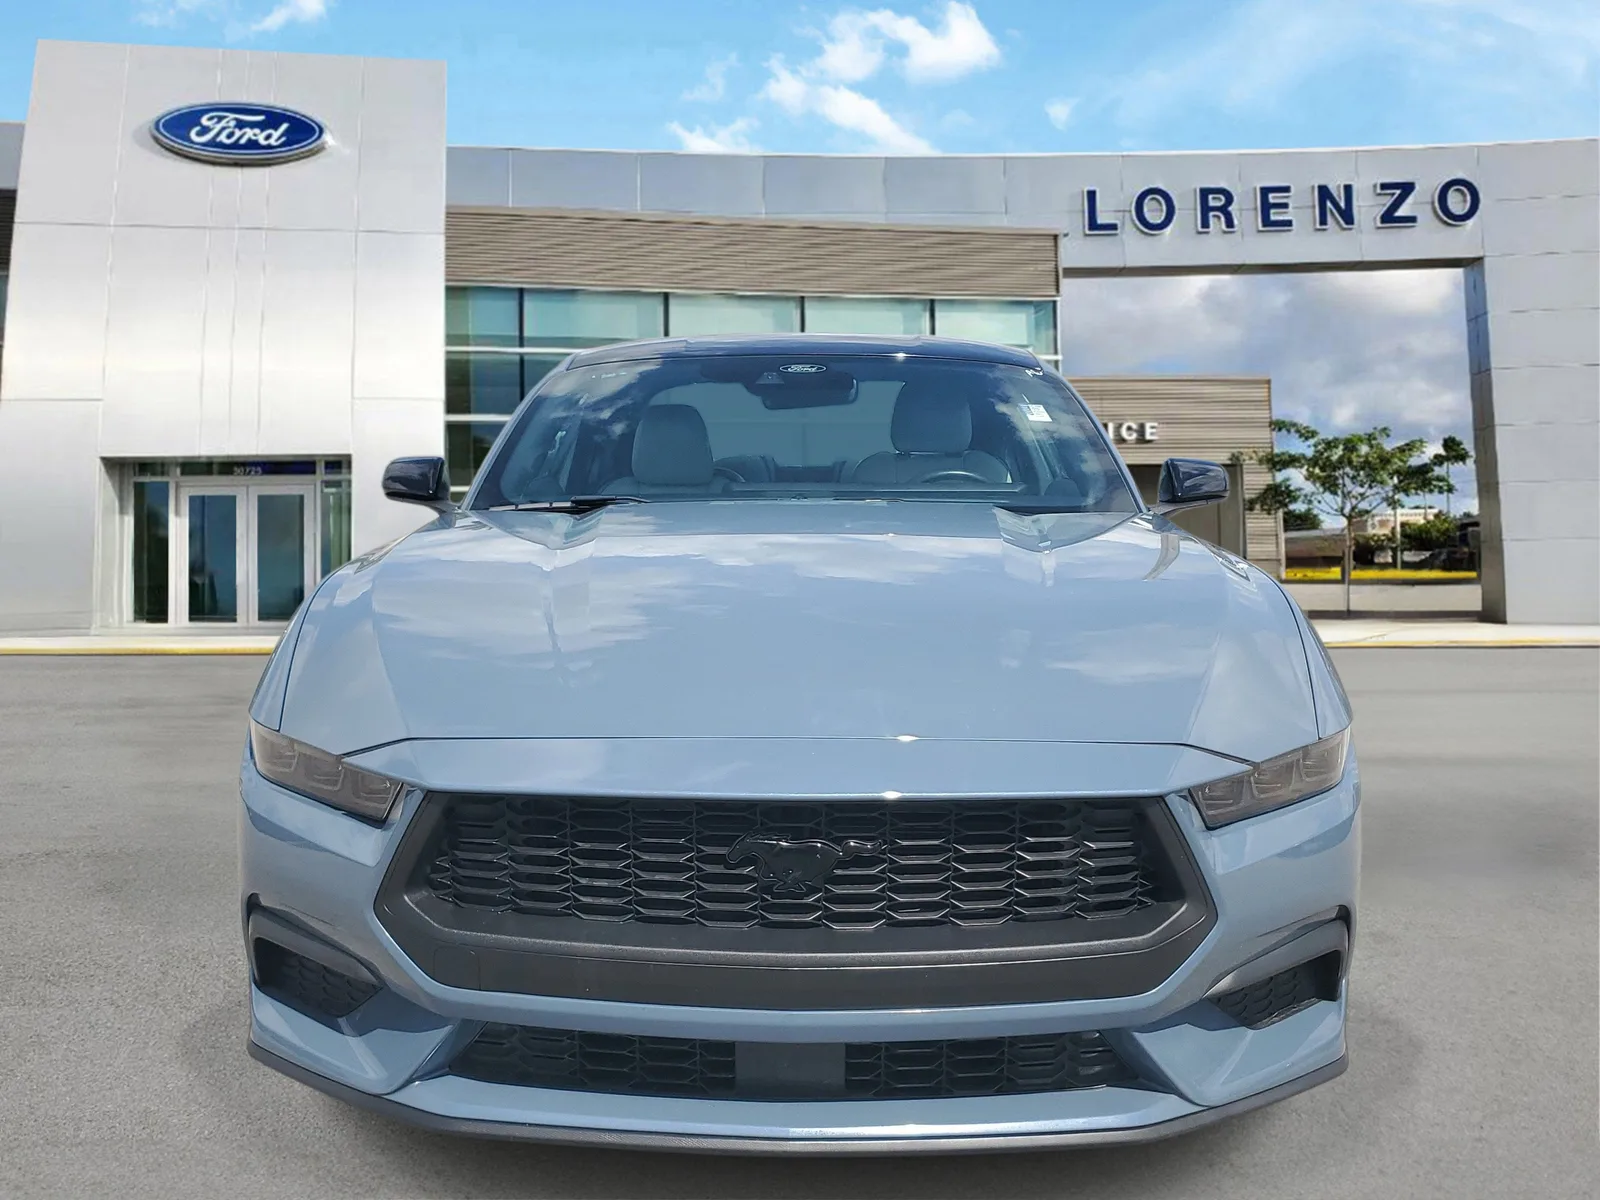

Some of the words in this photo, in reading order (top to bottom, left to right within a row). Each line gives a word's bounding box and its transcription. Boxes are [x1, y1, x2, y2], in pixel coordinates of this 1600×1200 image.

[189, 111, 290, 146] Ford
[1084, 178, 1481, 234] LORENZO
[787, 364, 818, 373] Ford
